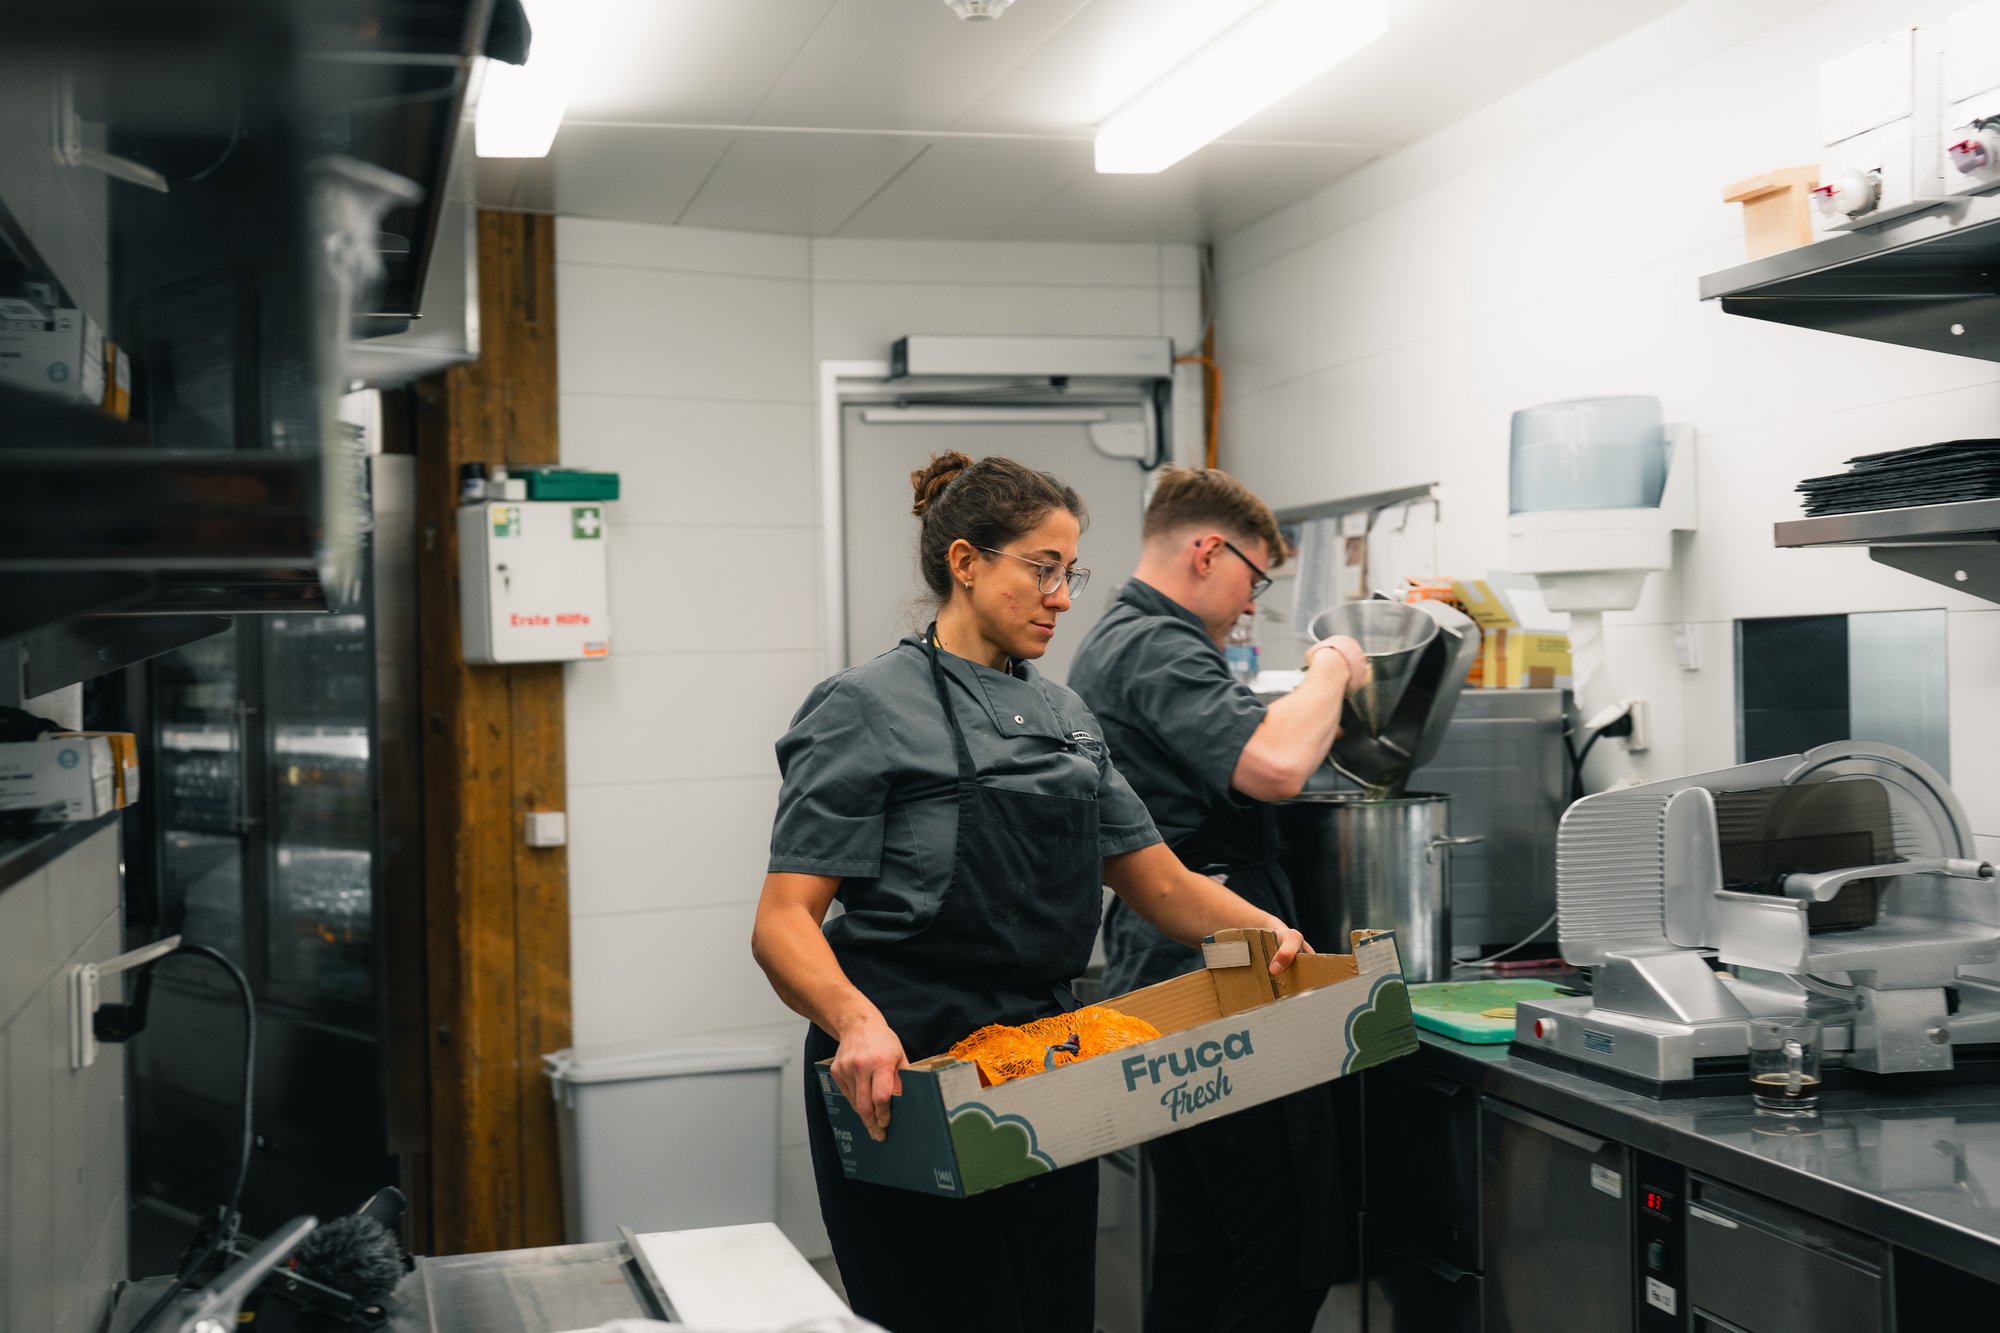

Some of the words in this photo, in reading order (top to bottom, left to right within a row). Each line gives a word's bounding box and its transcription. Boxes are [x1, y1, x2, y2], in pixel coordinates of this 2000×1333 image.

[511, 614, 550, 627] Erste
[556, 612, 590, 625] Hilfe
[1121, 1029, 1255, 1093] Fruca
[1160, 1066, 1233, 1122] Fresh
